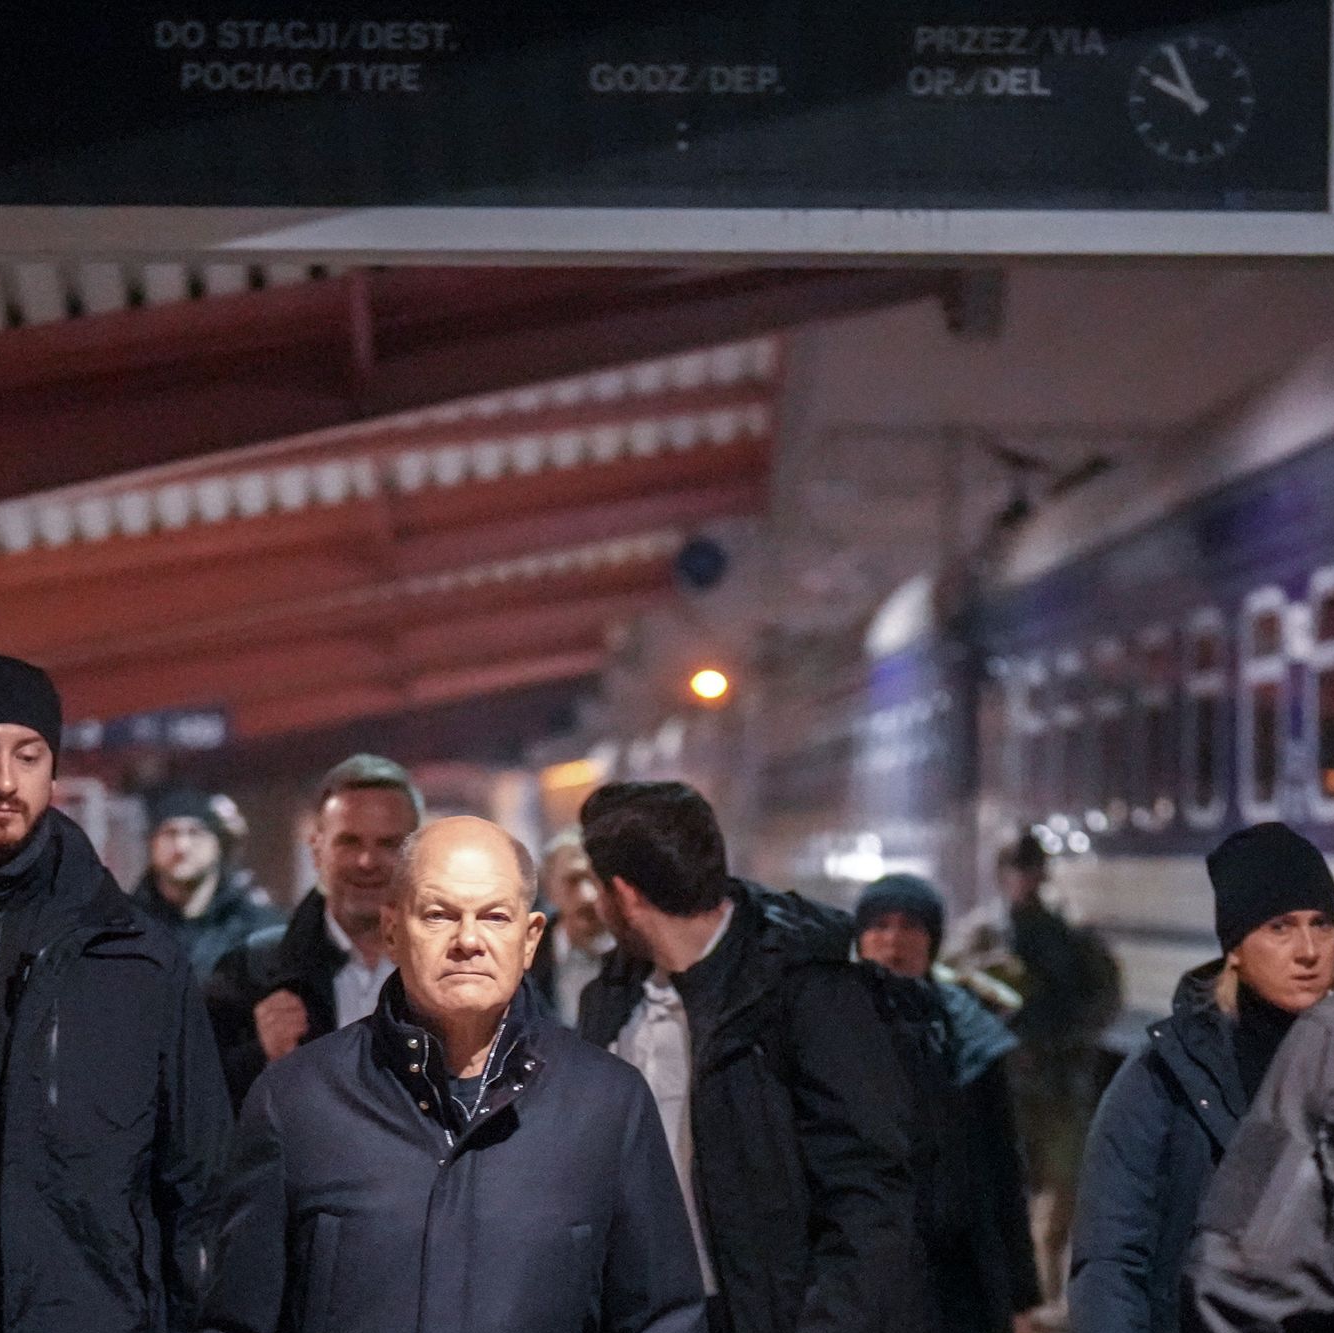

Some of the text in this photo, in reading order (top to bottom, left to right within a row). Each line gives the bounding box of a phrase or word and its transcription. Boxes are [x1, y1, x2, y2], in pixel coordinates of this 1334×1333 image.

[155, 19, 458, 51] DO STACJI/DEST.
[914, 26, 1107, 56] PRZEZ/VIA
[588, 63, 786, 95] GODZ/DEP.
[908, 67, 1052, 95] OP./DEL
